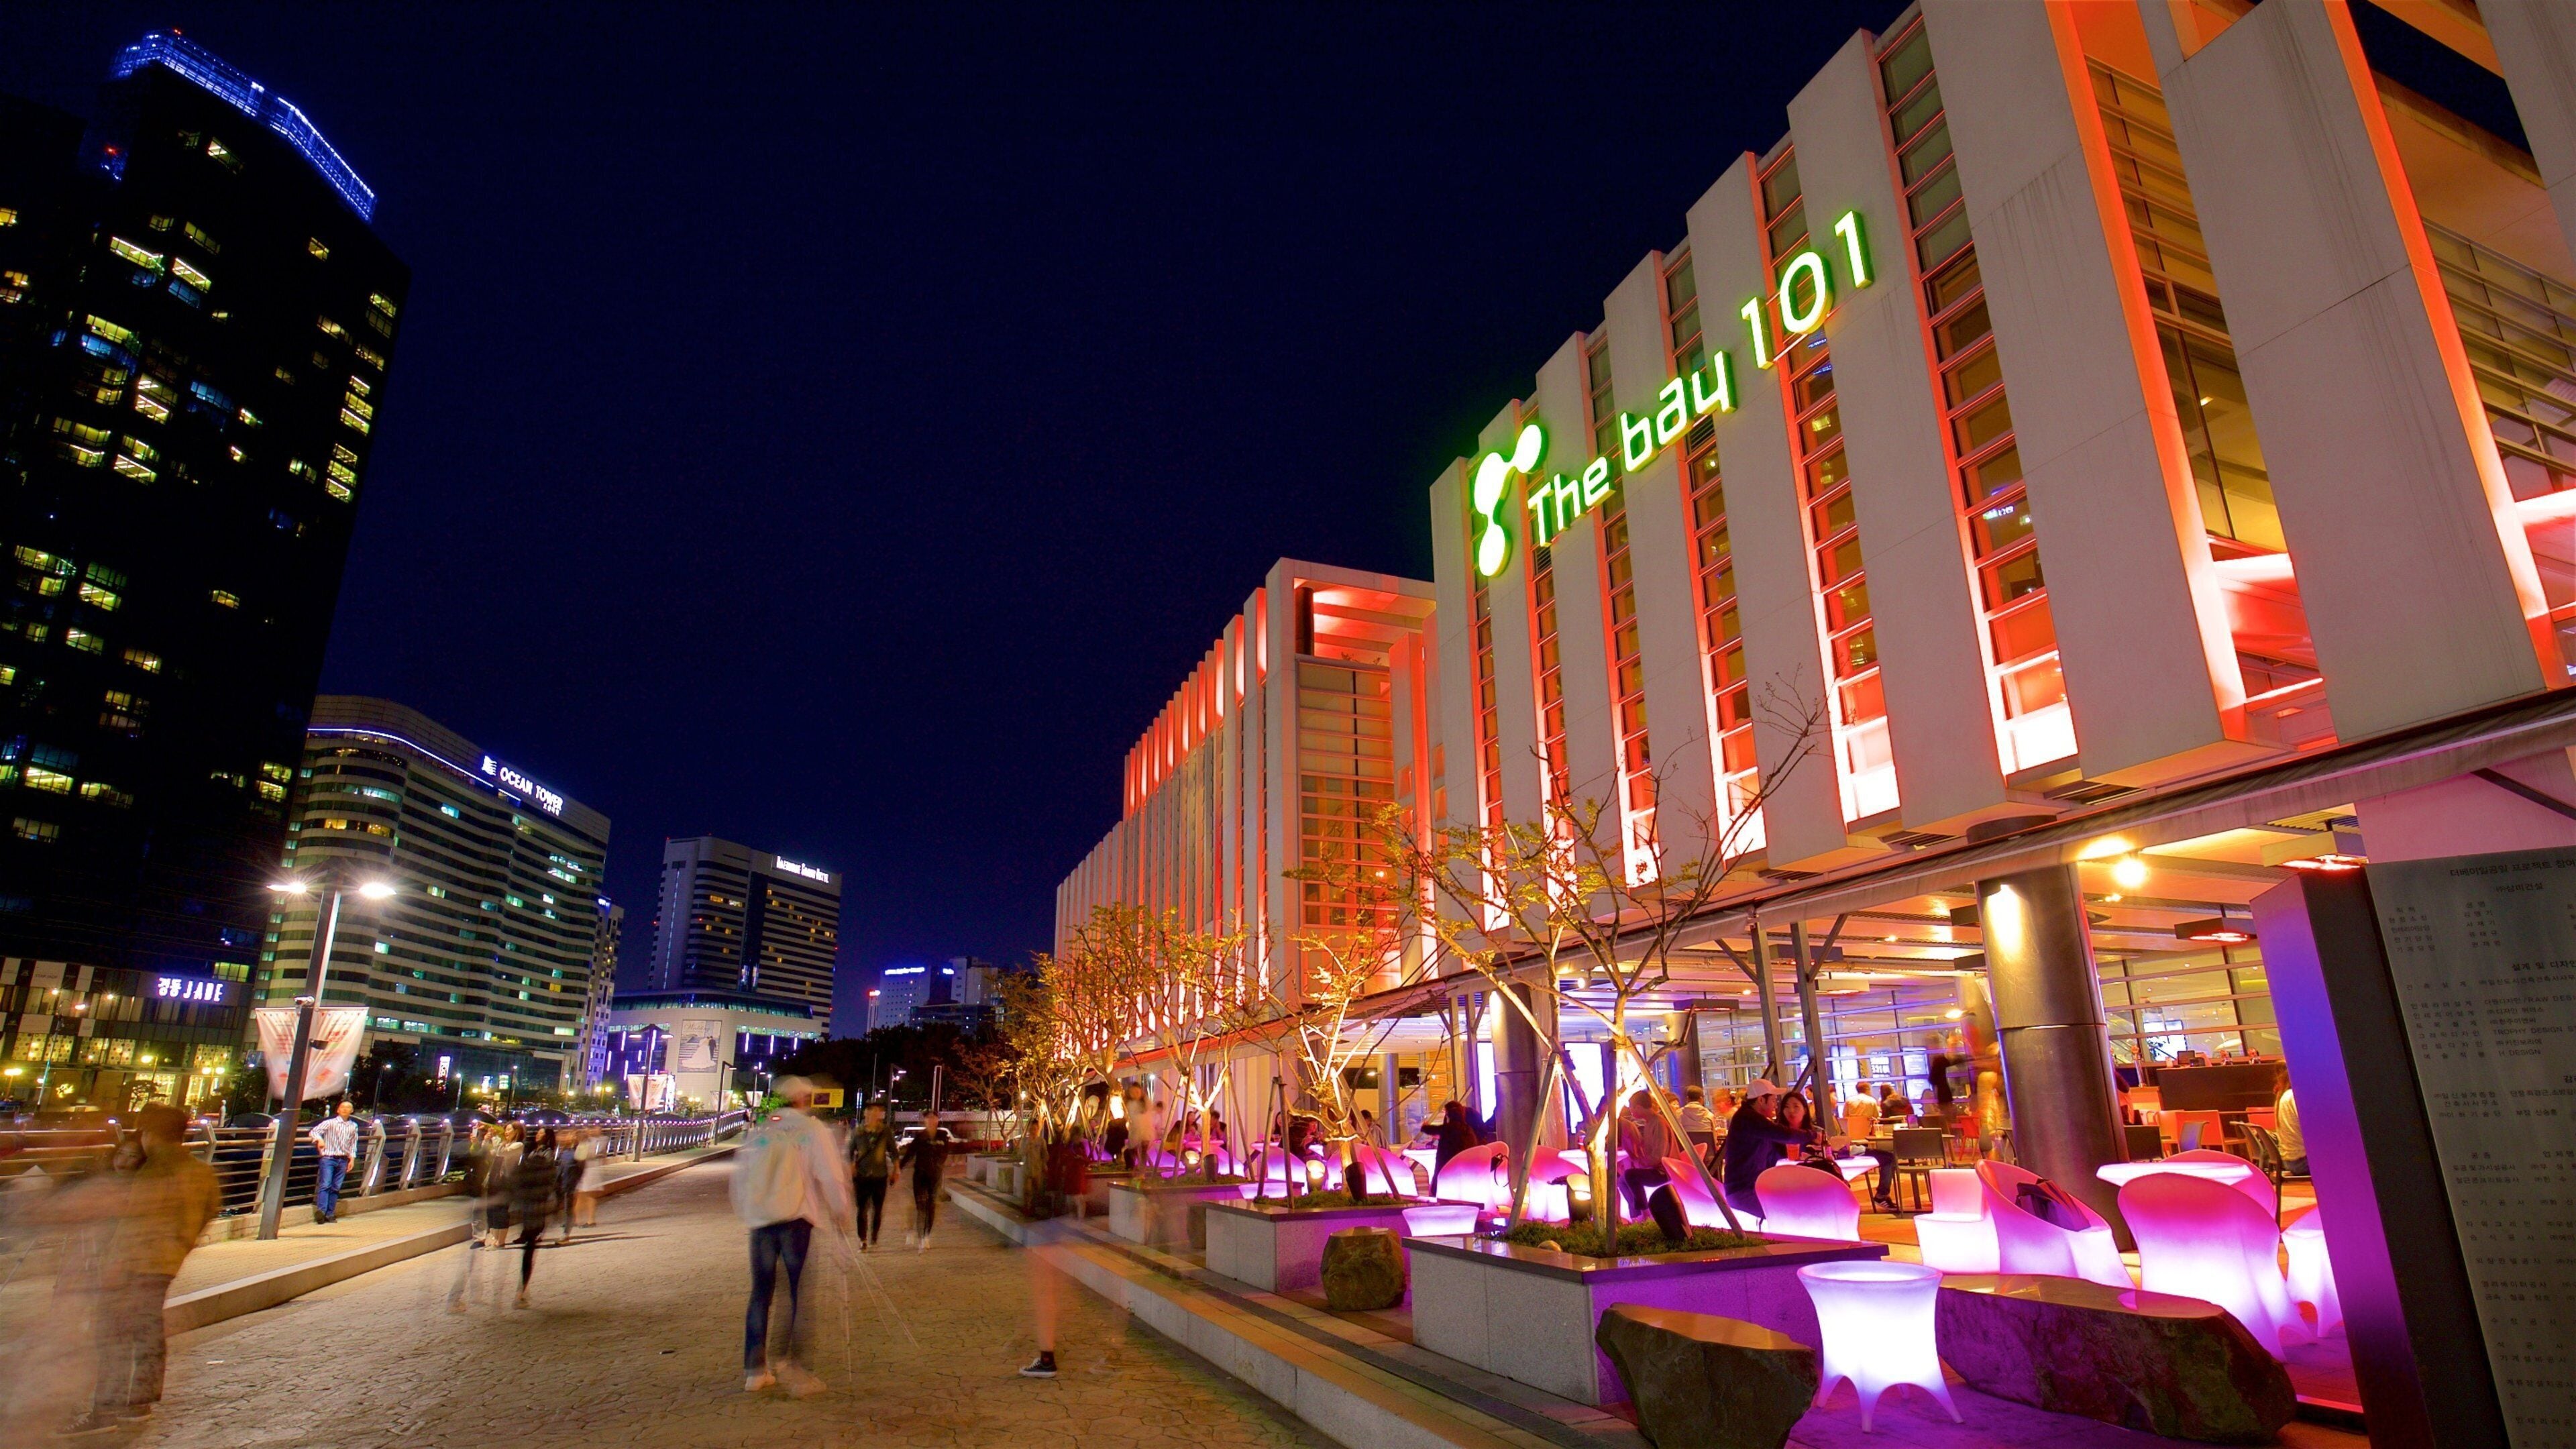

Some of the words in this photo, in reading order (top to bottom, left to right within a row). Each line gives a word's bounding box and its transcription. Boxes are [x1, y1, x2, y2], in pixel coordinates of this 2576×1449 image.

[1527, 457, 1614, 547] The
[1619, 350, 1737, 472] bay
[1741, 211, 1872, 370] 101
[500, 767, 533, 795] OCEAN
[535, 785, 564, 810] TOWER
[2530, 1026, 2563, 1034] DESIGN
[2509, 1049, 2541, 1057] DESIGN
